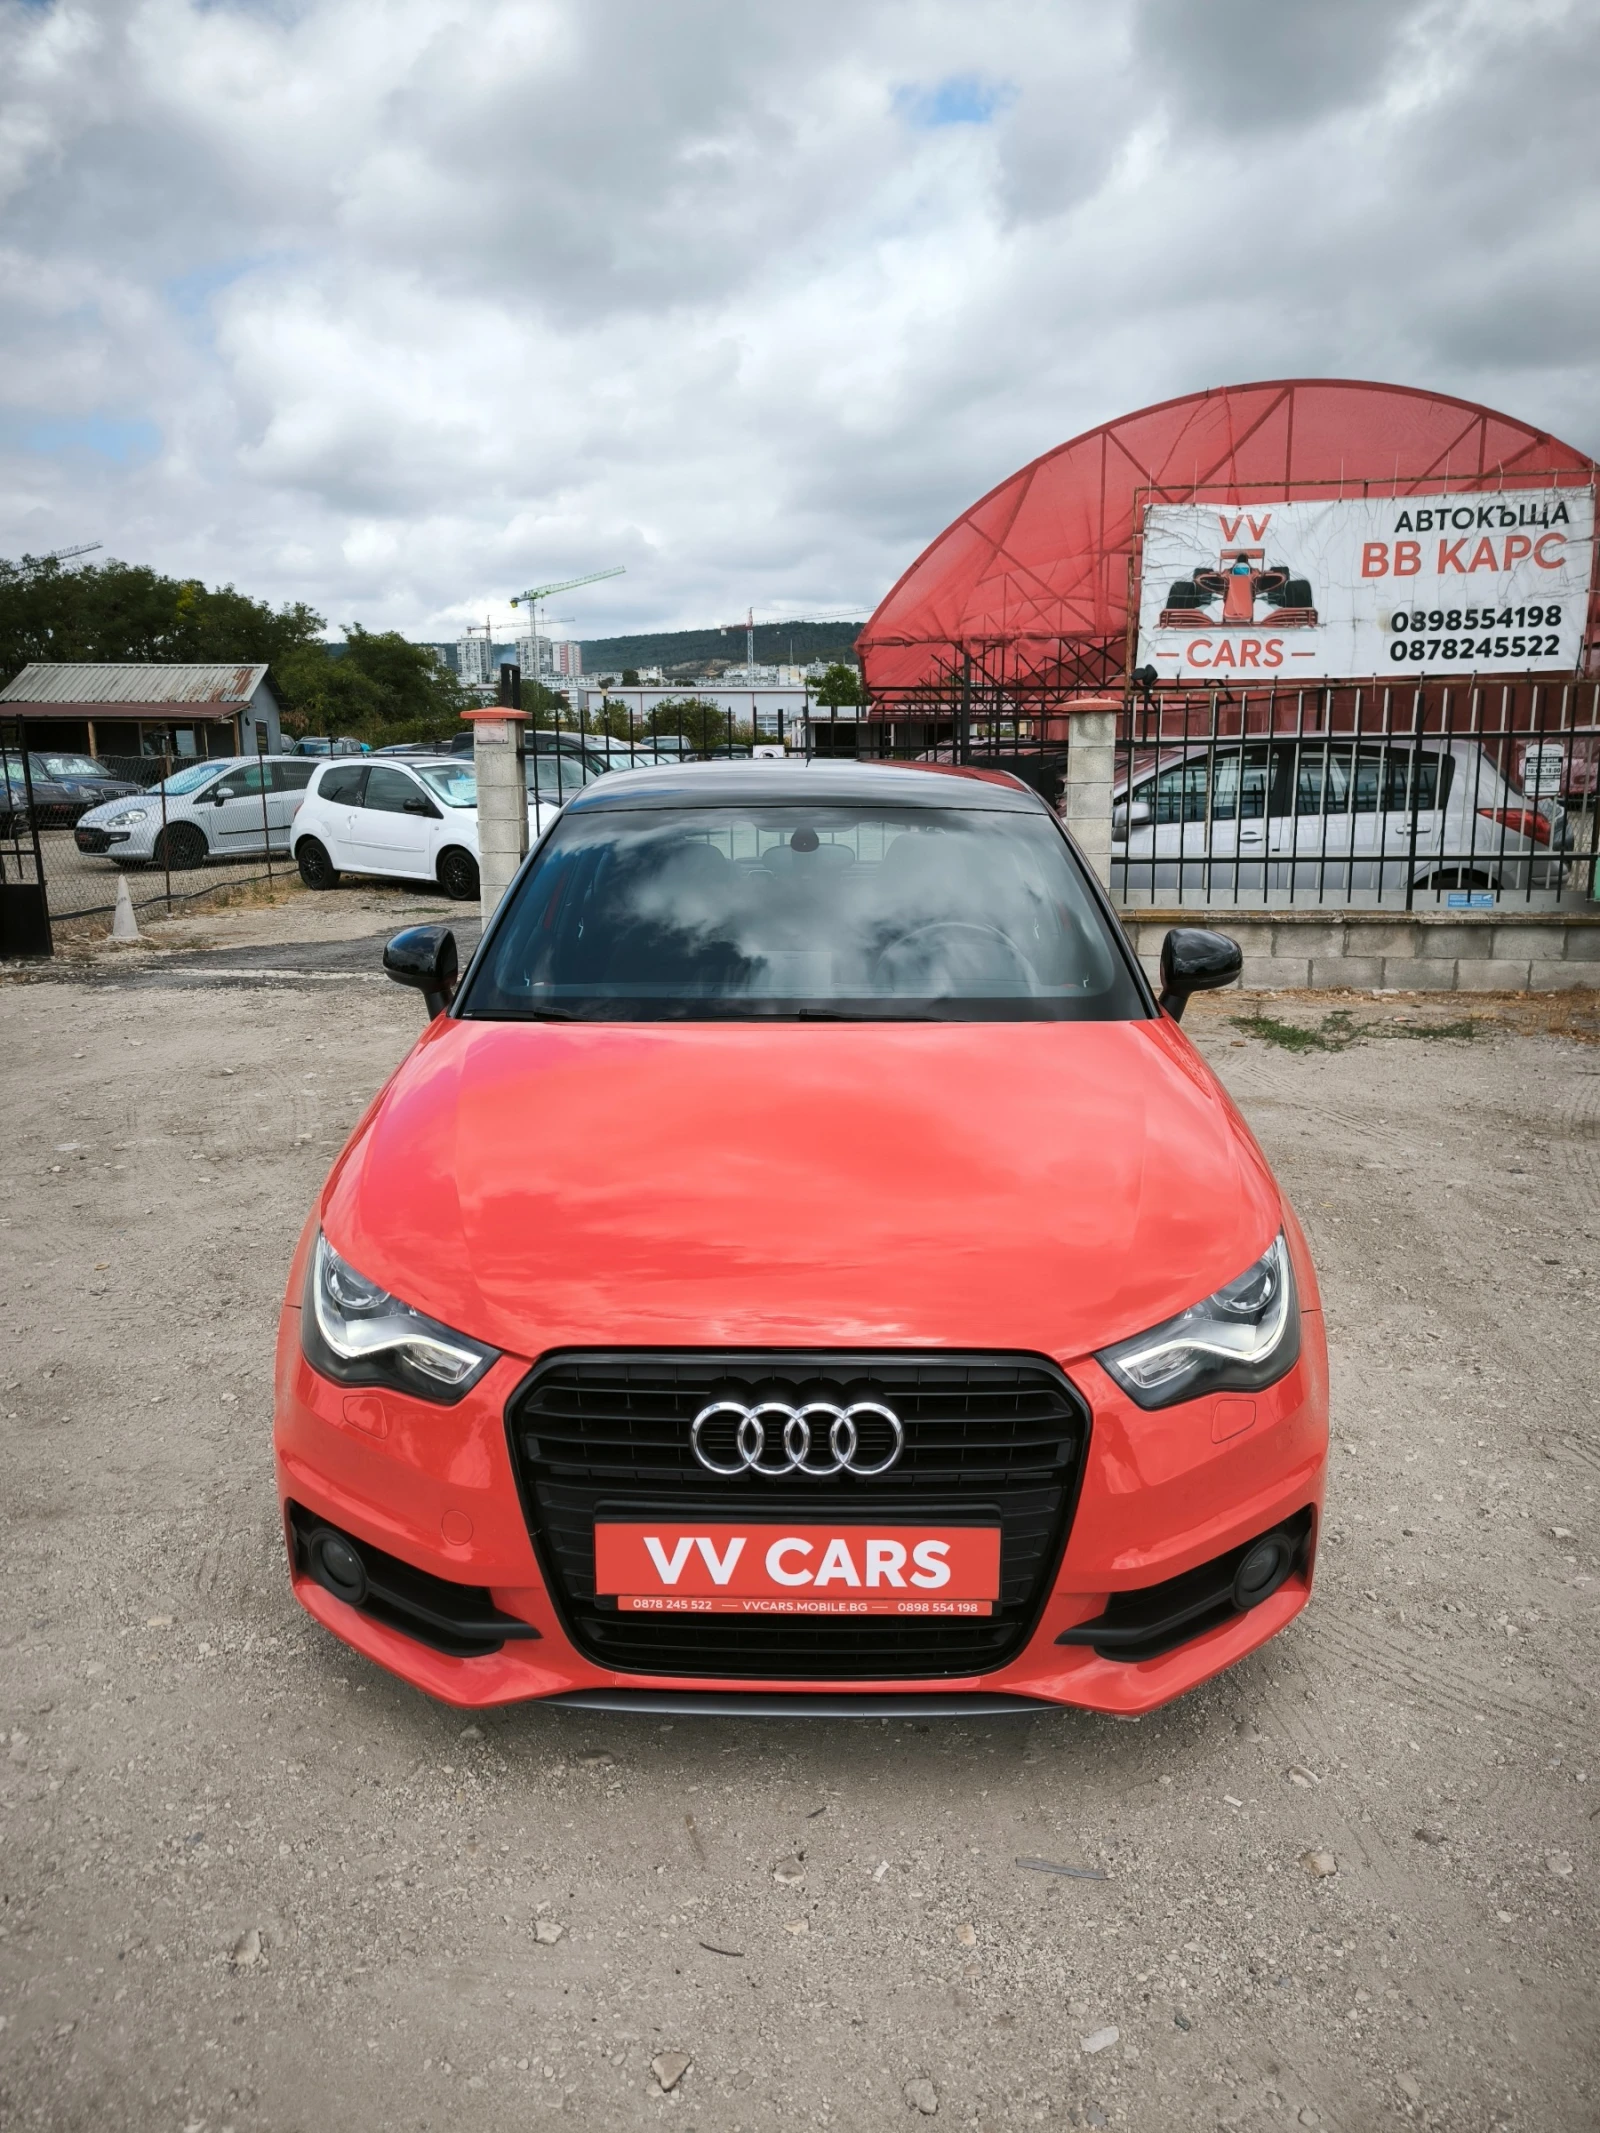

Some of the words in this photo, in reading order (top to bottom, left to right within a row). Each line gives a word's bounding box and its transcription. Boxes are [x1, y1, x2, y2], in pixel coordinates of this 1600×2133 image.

[1219, 513, 1272, 542] VV
[1394, 501, 1570, 533] АВТОКЪЩА
[1361, 541, 1422, 578] ВВ
[1437, 532, 1568, 575] КАРС
[1391, 605, 1562, 633] 0898554198
[1186, 638, 1285, 668] CARS
[1390, 634, 1560, 662] 0878245522
[642, 1536, 747, 1585] VV
[764, 1537, 952, 1589] CARS
[632, 1598, 663, 1609] 0878
[666, 1599, 688, 1609] 245
[691, 1600, 712, 1610] 522
[742, 1601, 868, 1612] VVCARS.MOBILE.BG
[897, 1602, 929, 1612] 0898
[932, 1603, 954, 1613] 554
[957, 1603, 978, 1613] 198
